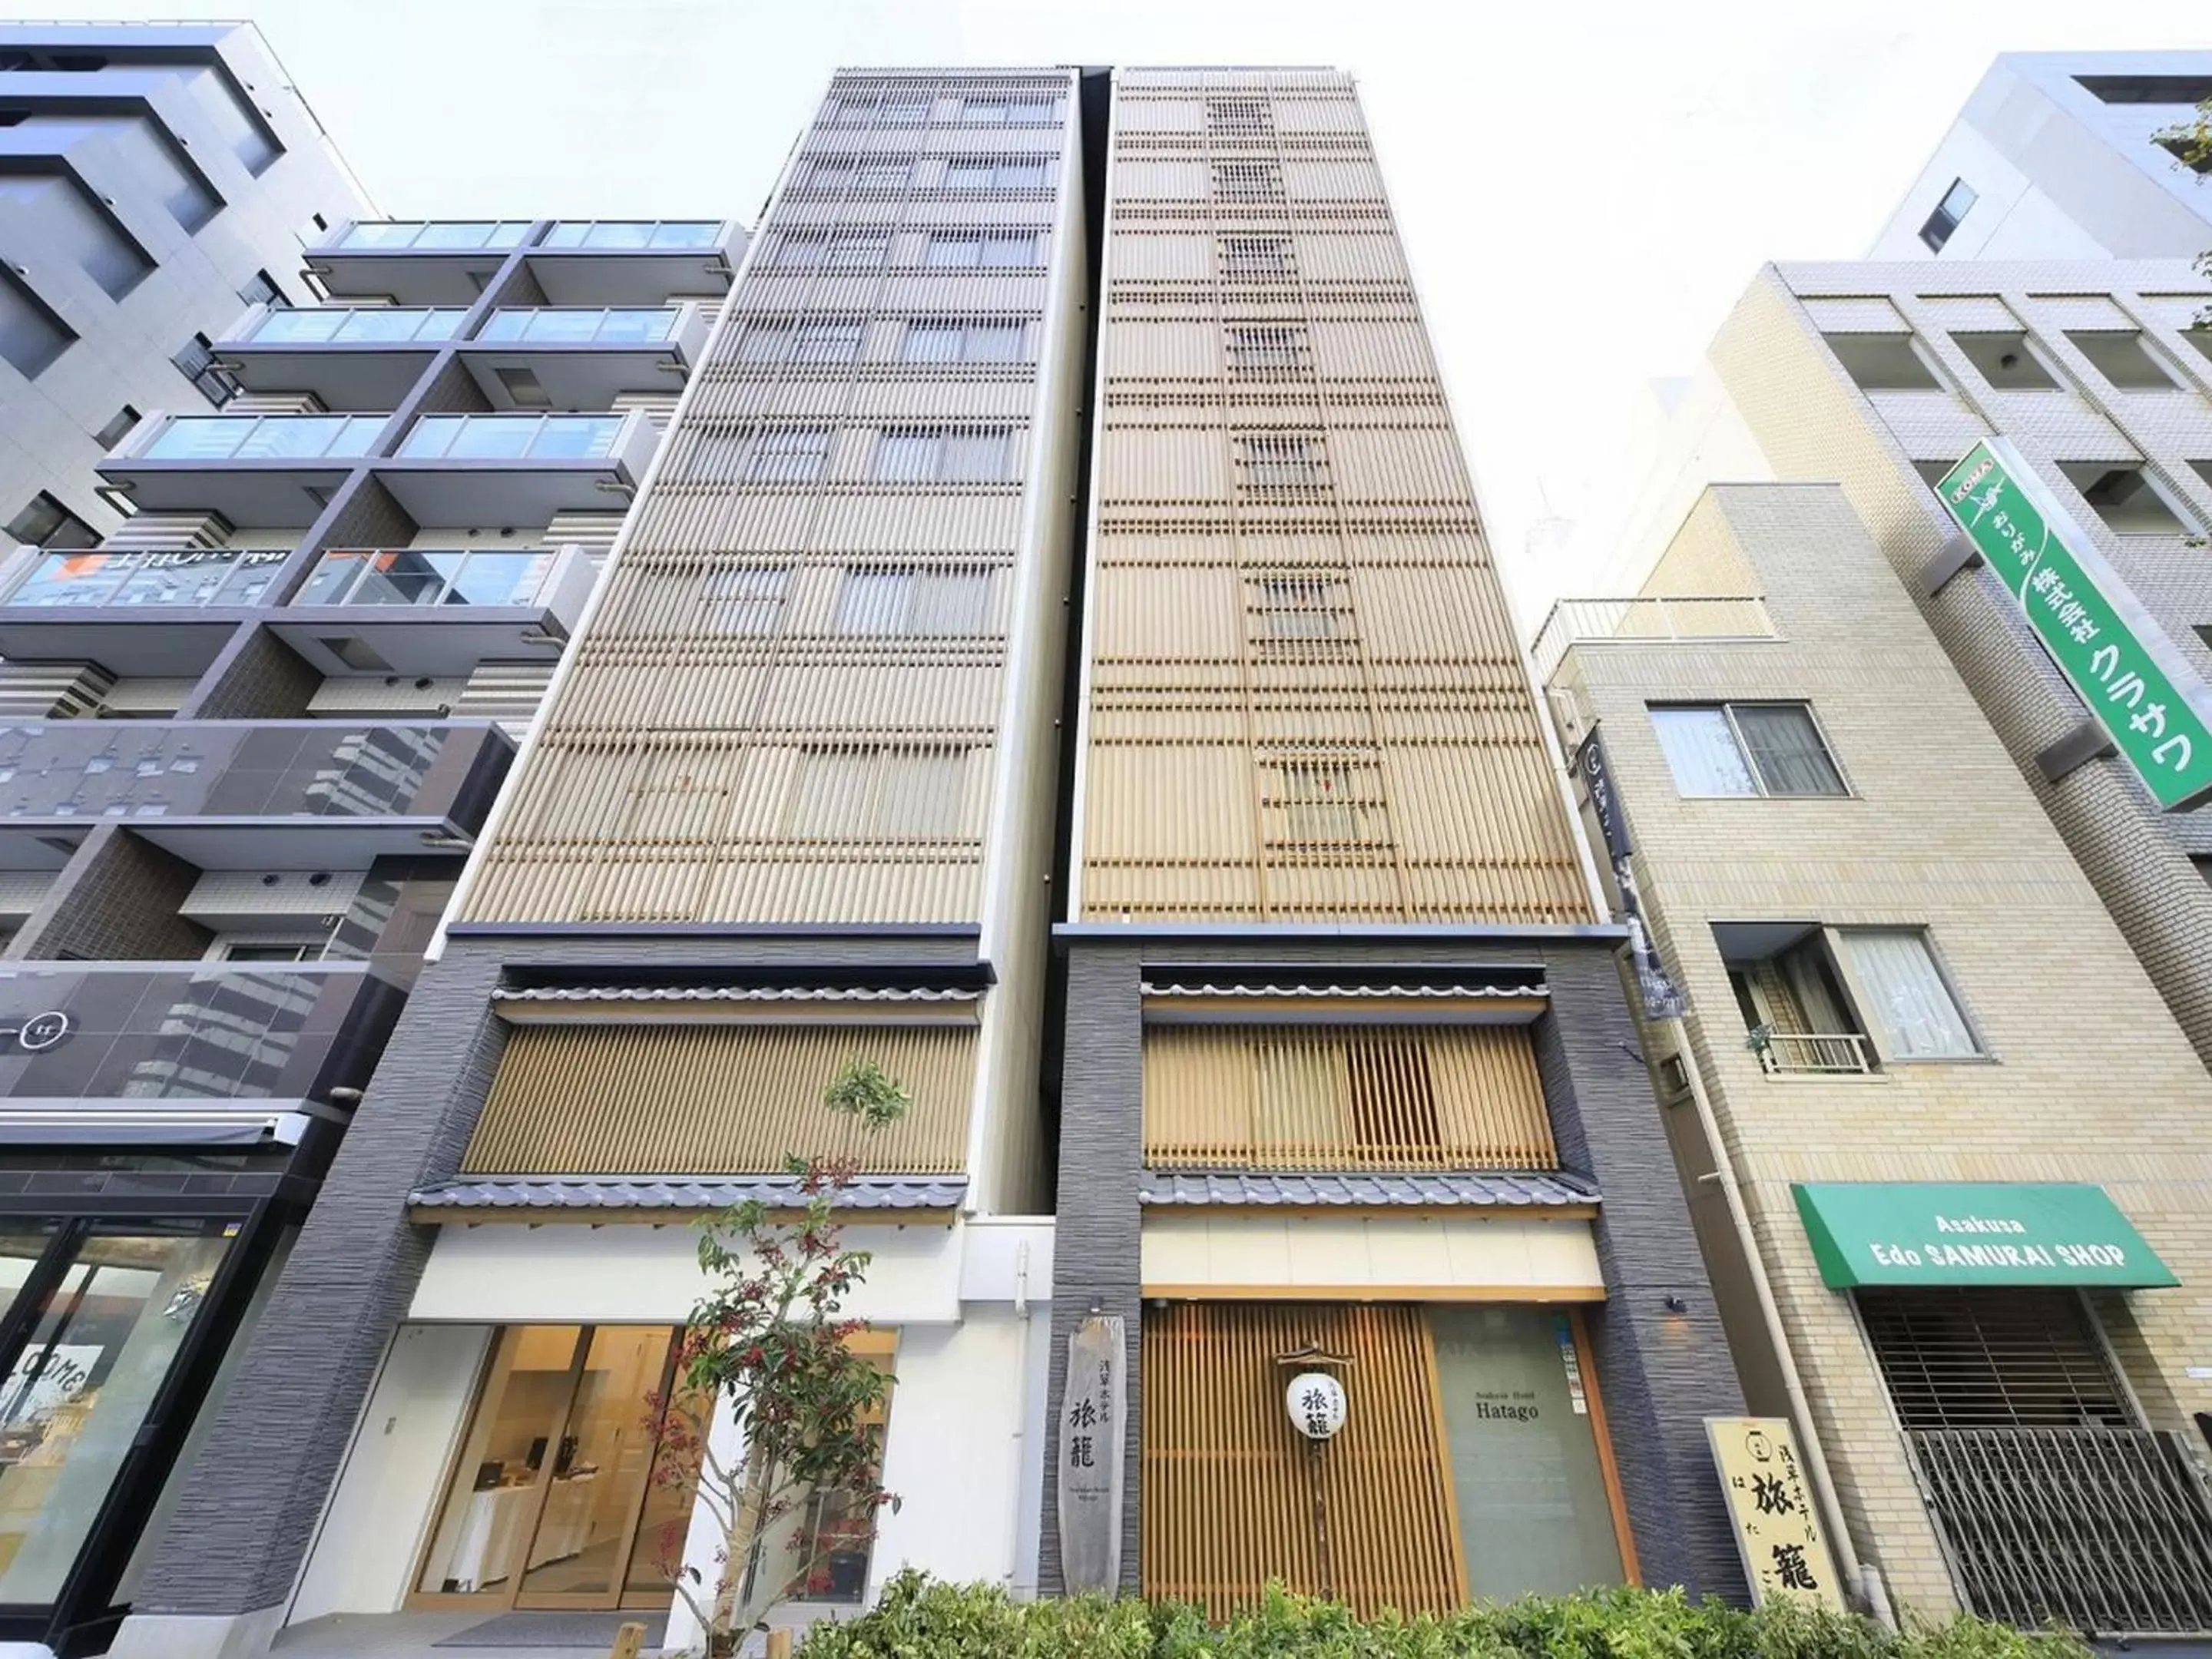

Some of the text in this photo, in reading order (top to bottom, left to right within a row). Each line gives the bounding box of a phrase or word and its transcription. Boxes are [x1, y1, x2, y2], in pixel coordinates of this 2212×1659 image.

[1935, 1214, 2027, 1234] Asakusa
[1869, 1243, 2126, 1268] Edo SAMURAI SHOP
[1475, 1402, 1539, 1422] Hatago
[1750, 1472, 1818, 1590] 旅籠
